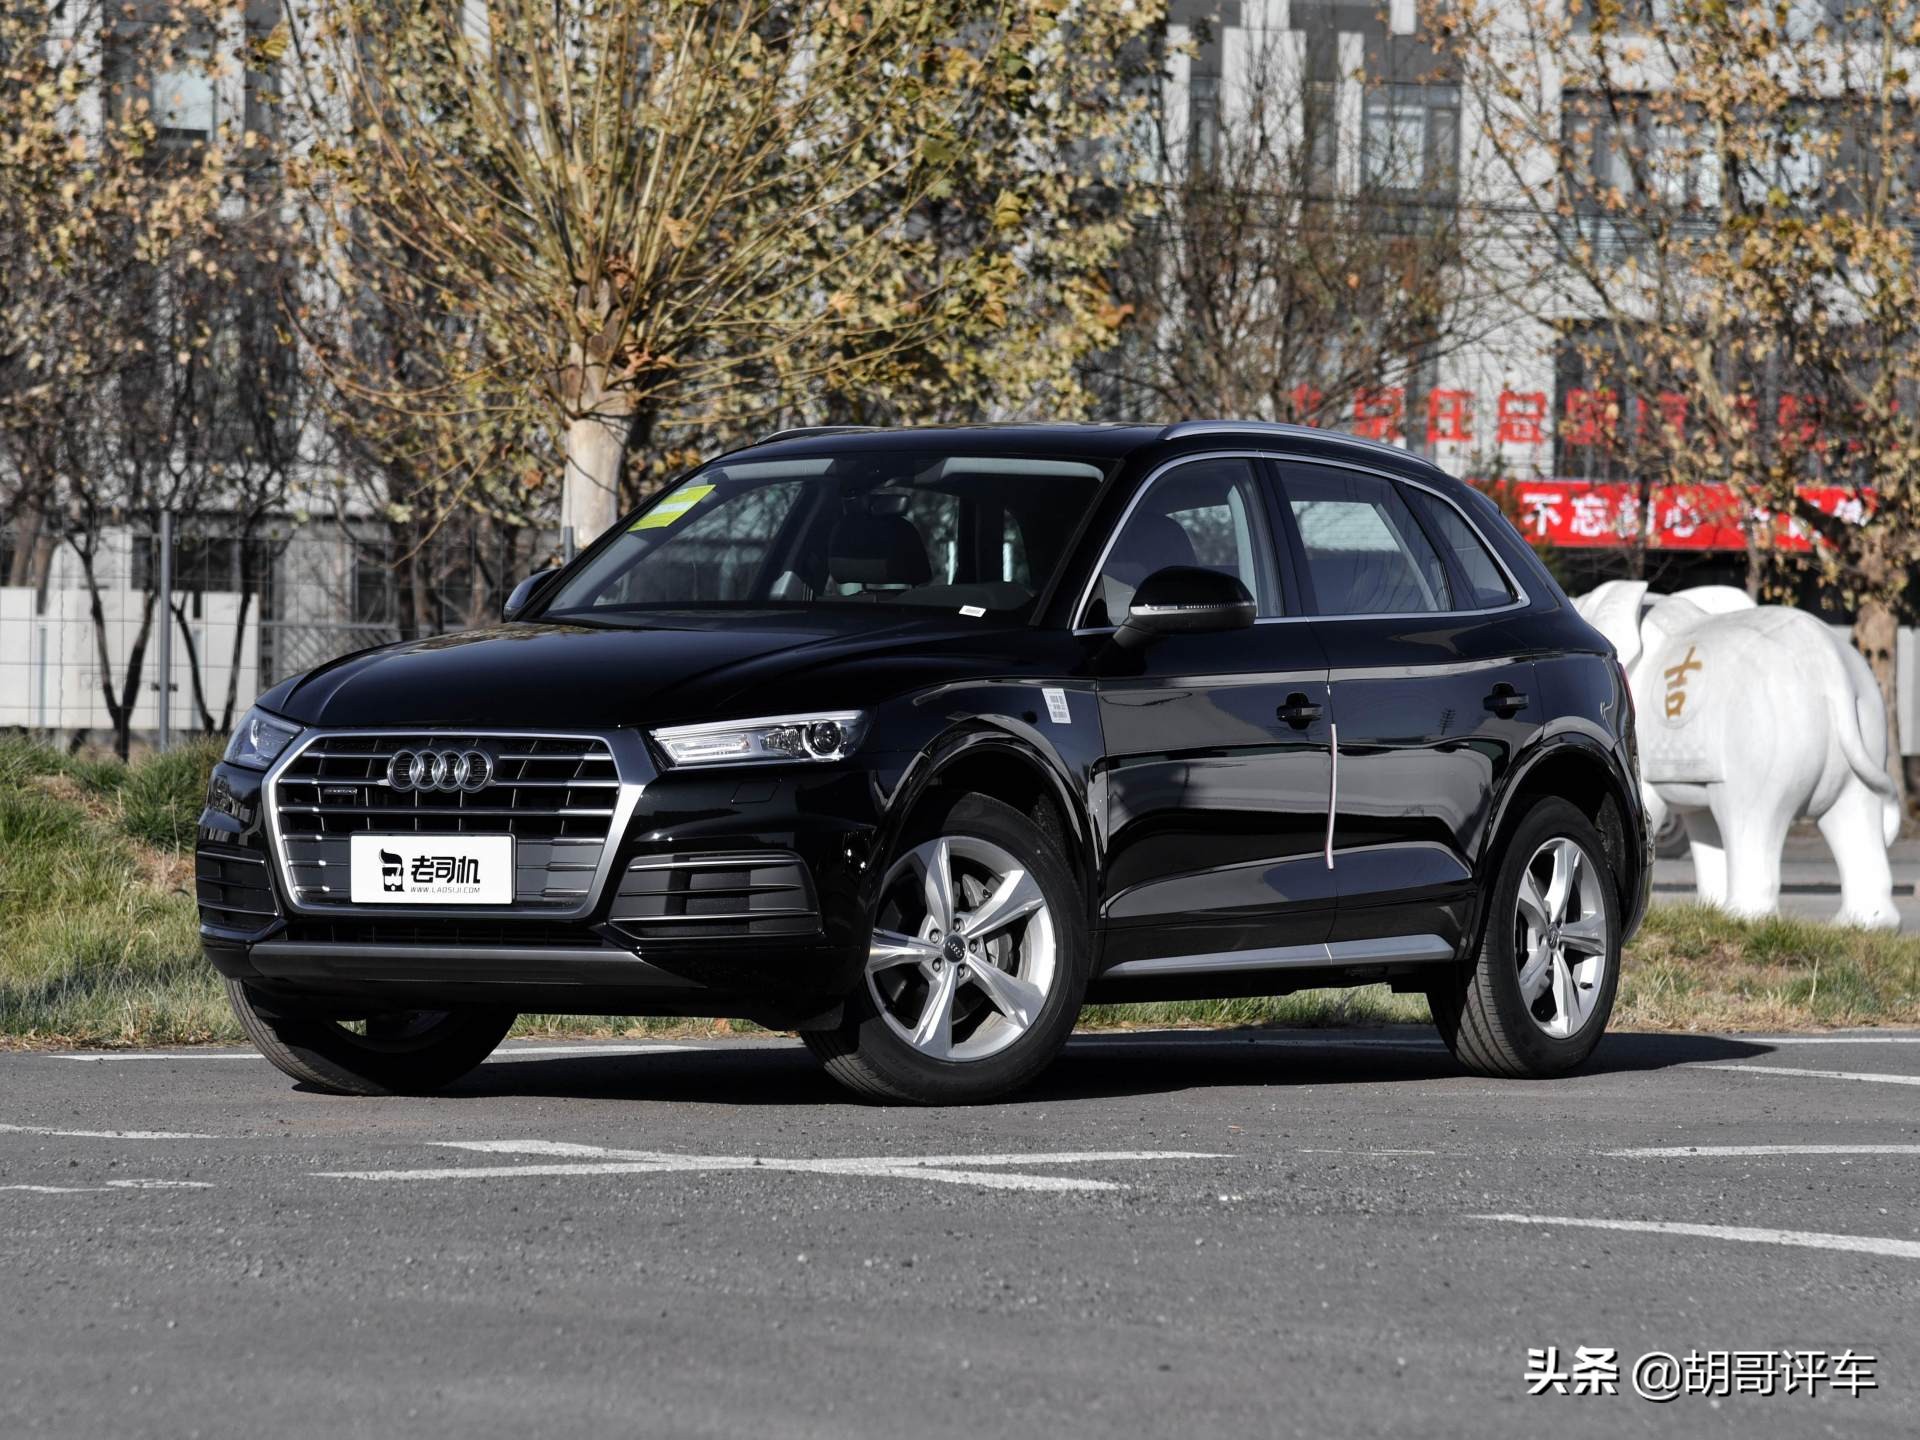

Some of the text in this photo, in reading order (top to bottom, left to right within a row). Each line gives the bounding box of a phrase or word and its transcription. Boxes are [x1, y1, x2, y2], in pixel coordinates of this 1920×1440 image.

[1663, 645, 1703, 720] 吉
[411, 855, 481, 884] 老司机
